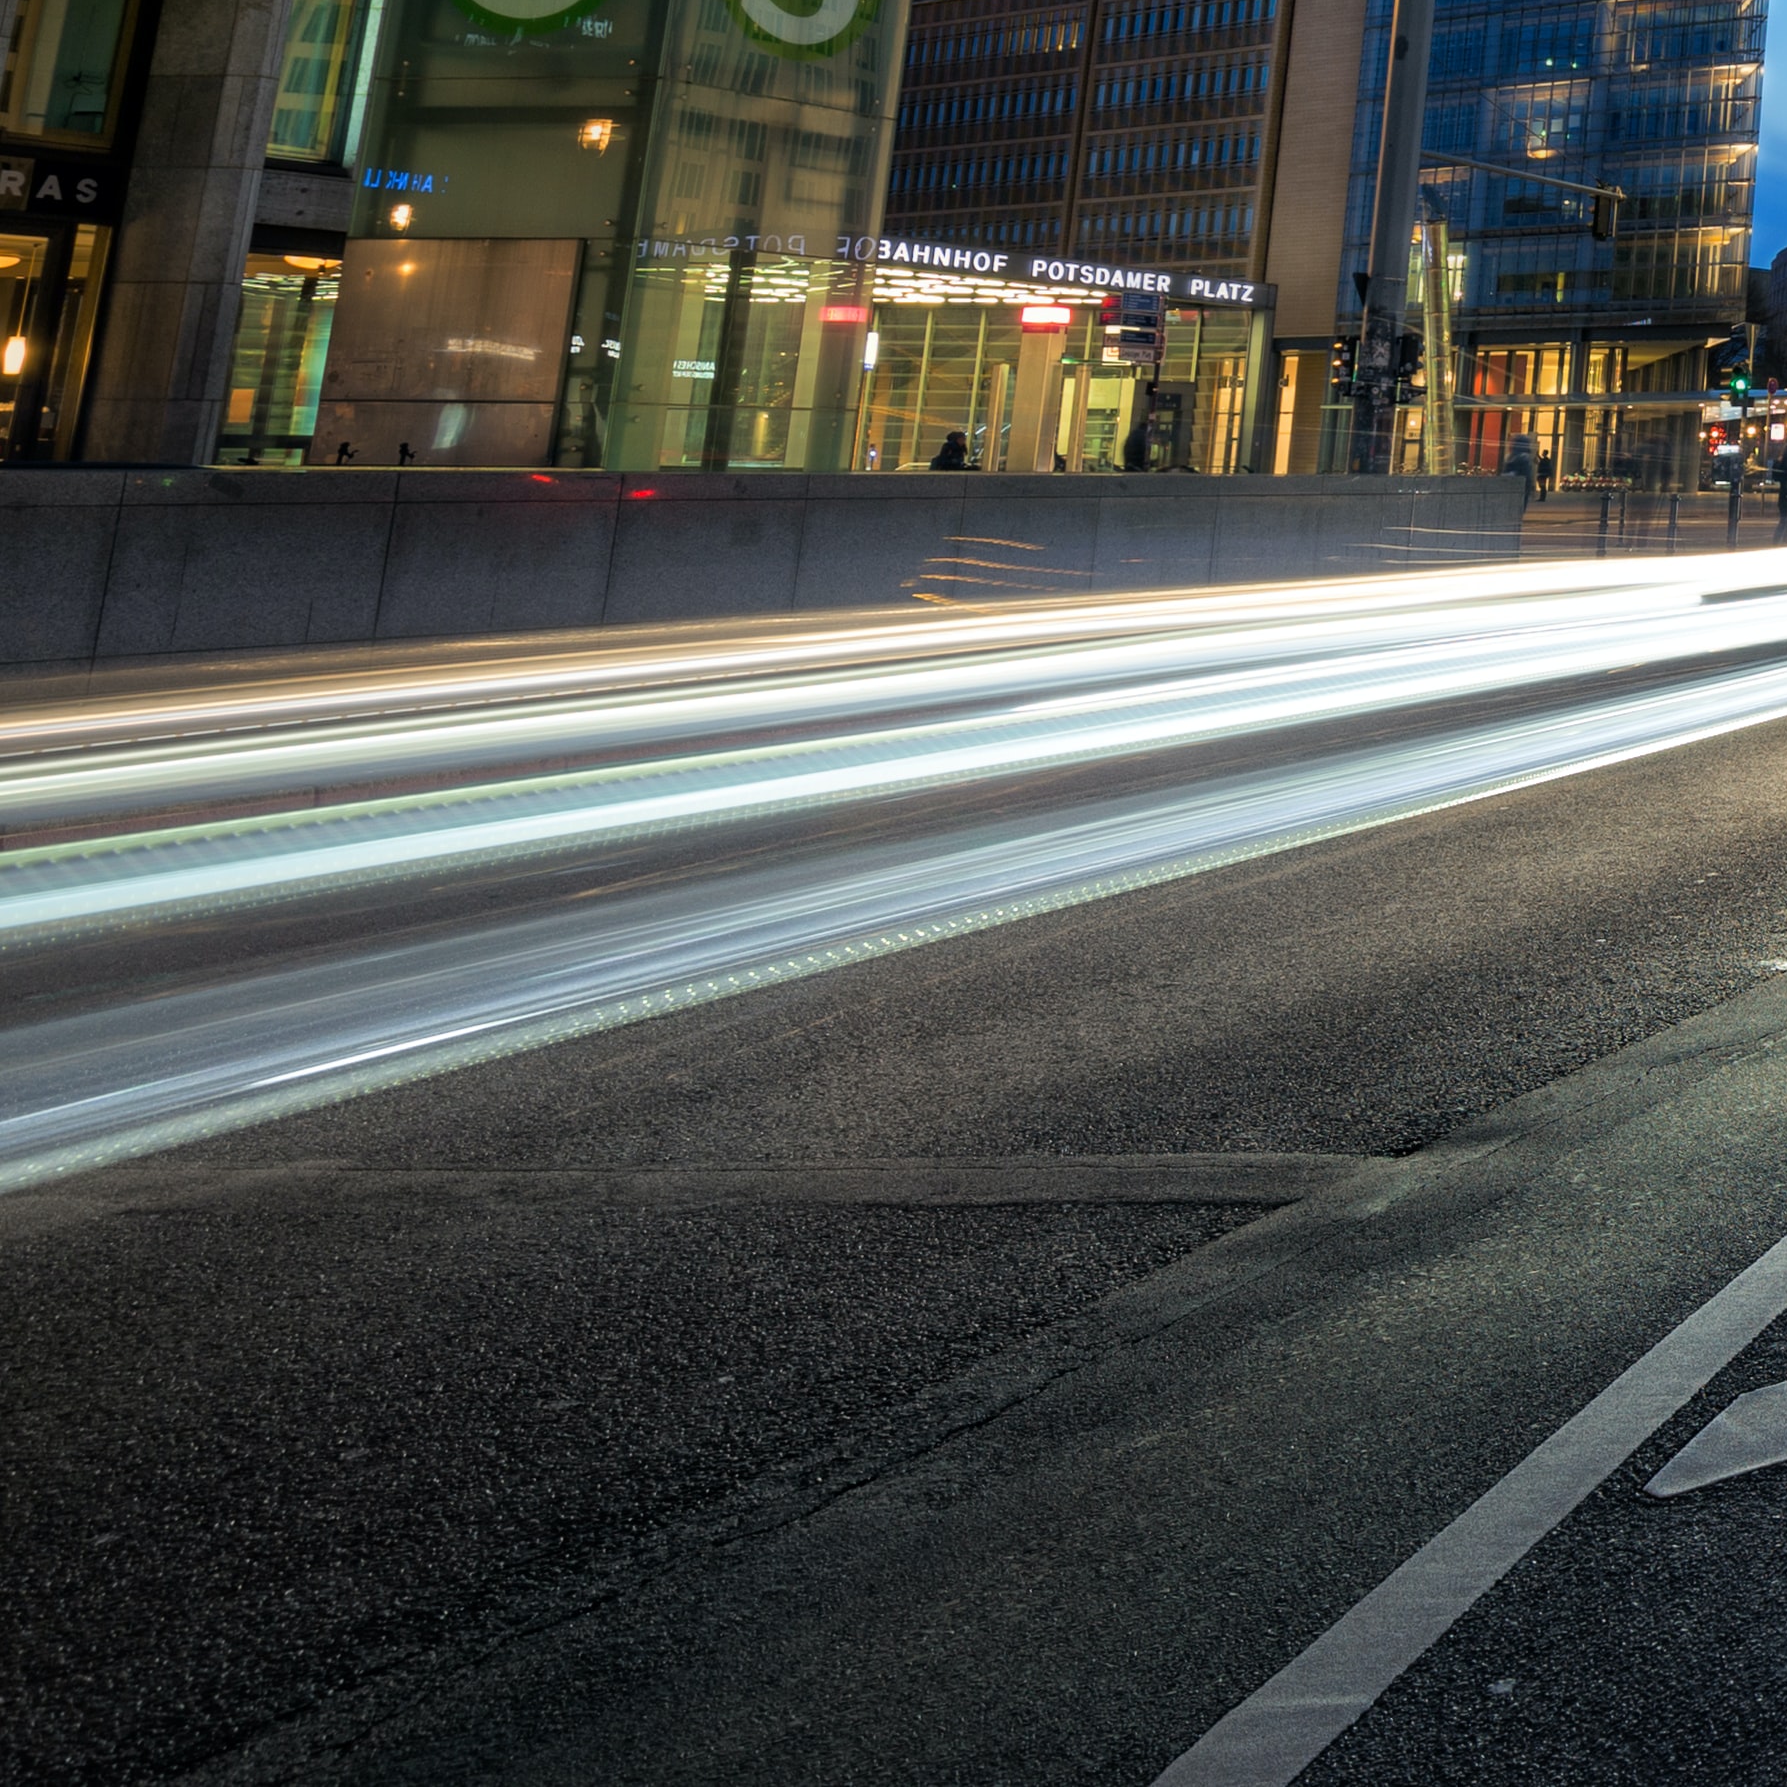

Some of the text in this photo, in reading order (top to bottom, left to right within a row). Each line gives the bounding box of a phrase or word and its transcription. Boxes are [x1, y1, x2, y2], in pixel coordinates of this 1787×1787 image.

[878, 240, 1008, 273] BAHNHOF
[1032, 259, 1171, 293] POTSDAMER
[1190, 279, 1254, 303] PLATZ
